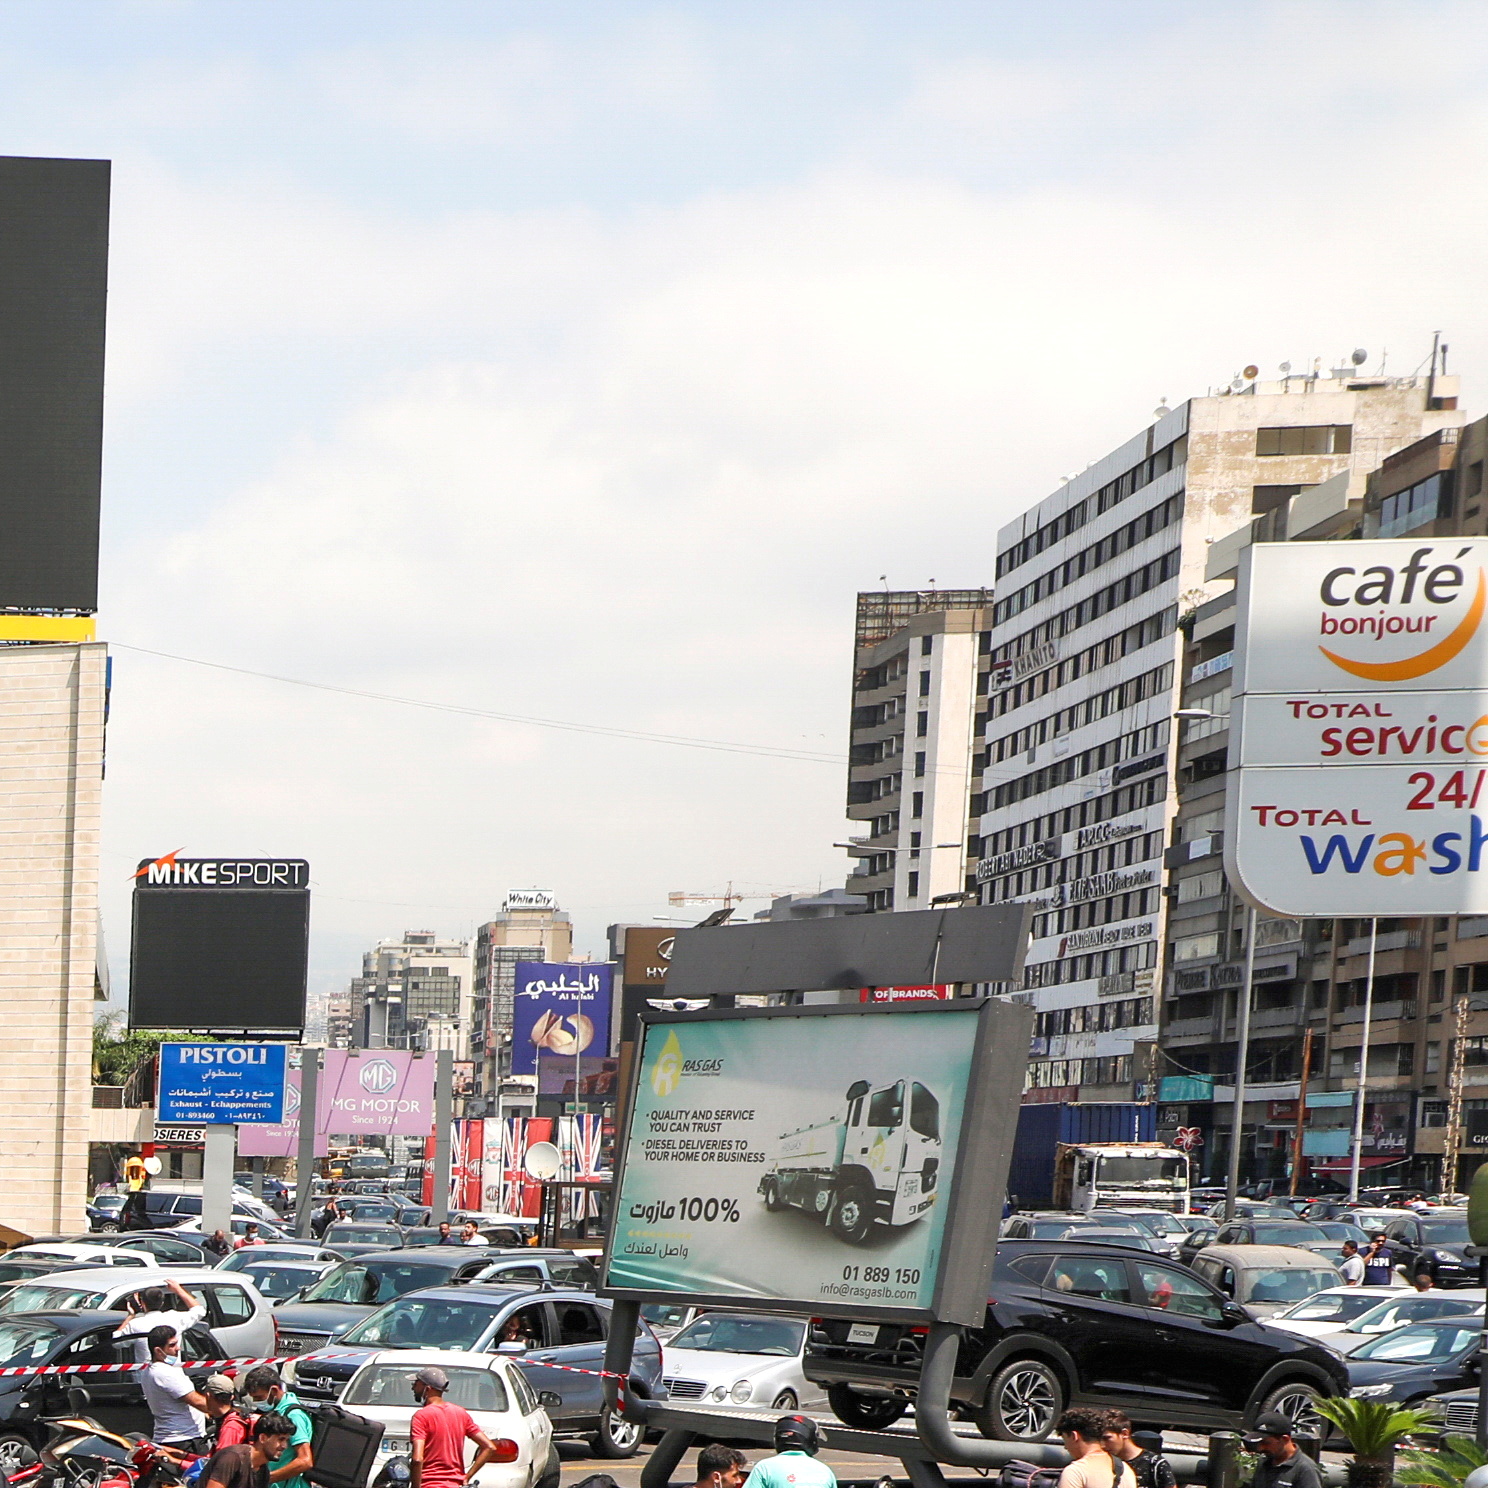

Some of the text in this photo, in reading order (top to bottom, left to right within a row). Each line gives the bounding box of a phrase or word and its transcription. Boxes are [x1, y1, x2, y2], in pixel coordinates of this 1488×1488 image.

[1321, 546, 1474, 607] café
[1320, 610, 1438, 641] bonjour
[1286, 701, 1394, 719] TOTAL
[1251, 805, 1373, 828] TOTAL
[535, 892, 554, 906] City
[526, 972, 600, 1000] الحلبي
[179, 1047, 267, 1065] PISTOLI
[682, 1058, 724, 1072] RAS GAS
[201, 1069, 243, 1082] بسطولي
[170, 1100, 272, 1109] Exhaust Echappements
[331, 1098, 421, 1113] MG MOTOR
[175, 1112, 216, 1120] 01-893460
[352, 1115, 374, 1125] Since
[650, 1109, 755, 1121] QUALITY AND SERVICE
[649, 1122, 722, 1133] YOU CAN TRUST
[645, 1139, 748, 1150] DIESEL DELIVERIES TO
[644, 1151, 765, 1163] YOUR HOME OR BUSINESS
[629, 1196, 741, 1225] 100% مازوت
[658, 1243, 689, 1260] واصل
[842, 1265, 920, 1285] 01 889 150
[820, 1283, 917, 1300] info@rasgaslb.com
